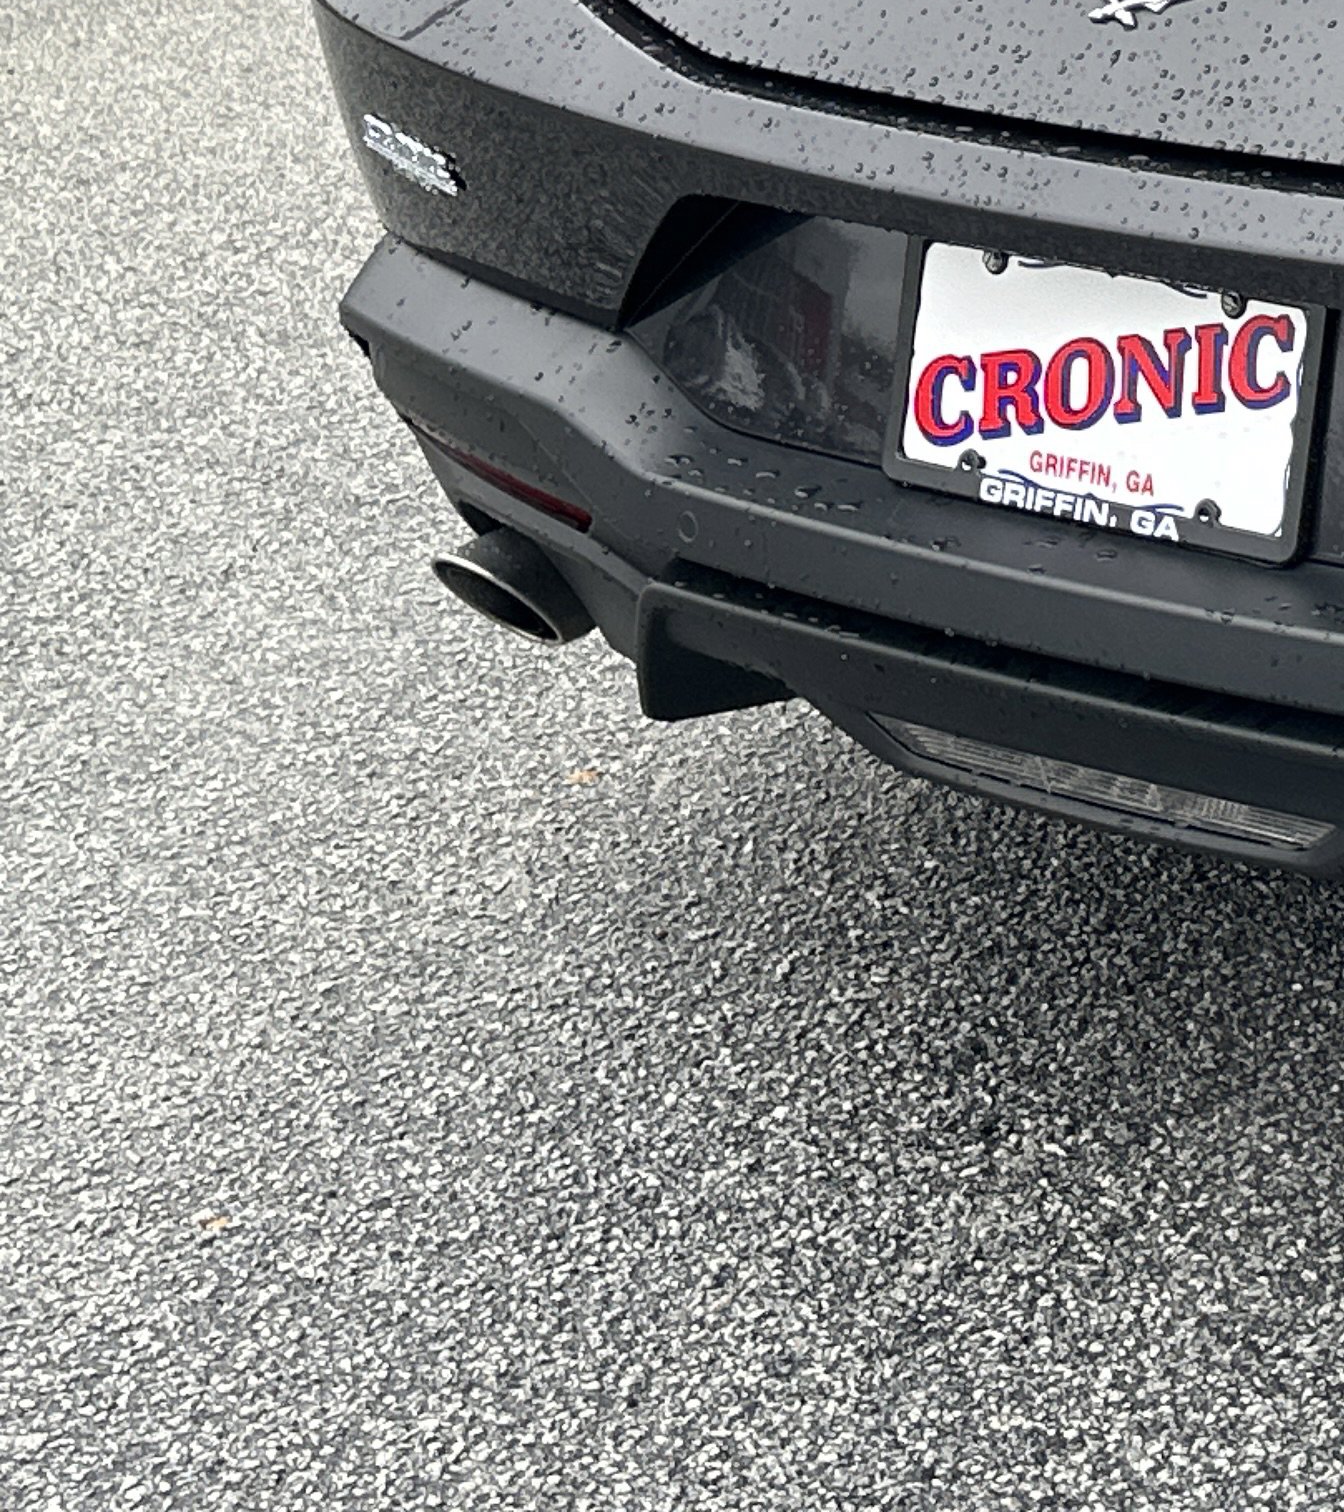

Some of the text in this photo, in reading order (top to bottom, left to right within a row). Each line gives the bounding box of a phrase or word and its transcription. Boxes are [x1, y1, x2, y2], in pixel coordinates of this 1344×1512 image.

[914, 314, 1295, 447] CRONIC
[1029, 450, 1155, 497] GRIFFIN, GA
[979, 477, 1180, 542] GRIFFIN, GA
